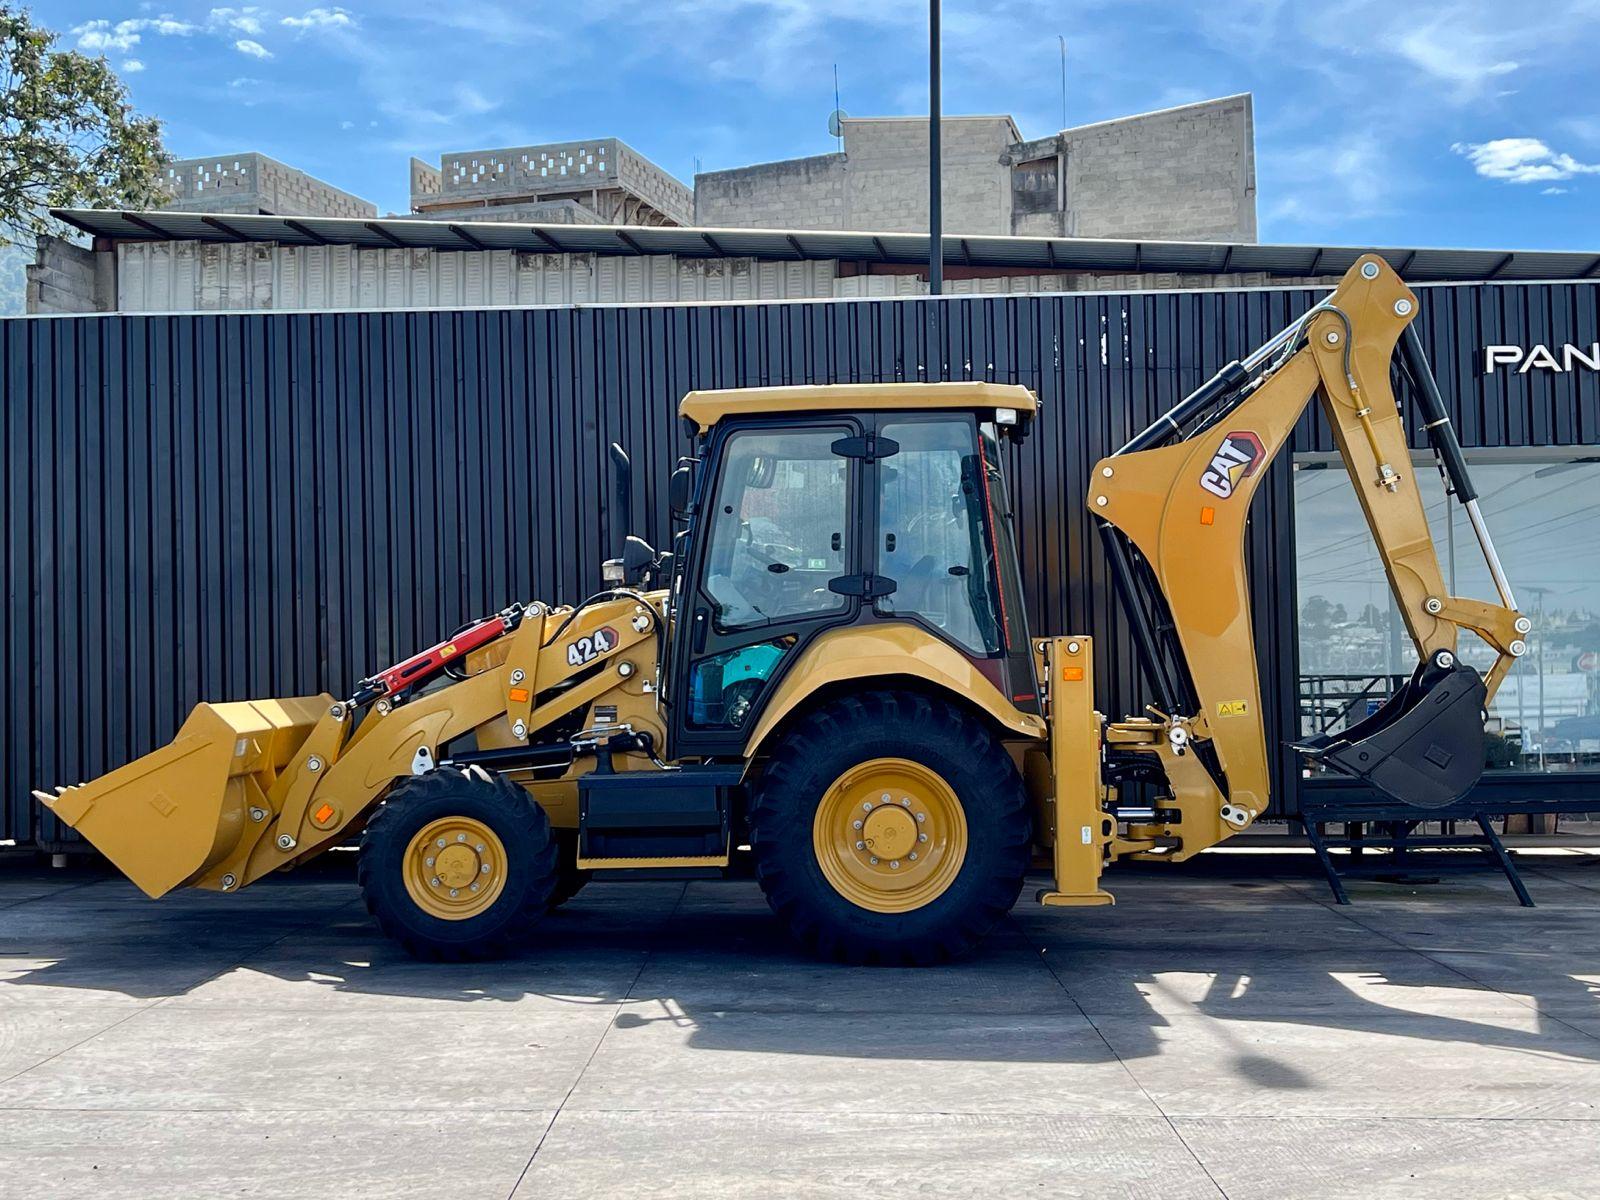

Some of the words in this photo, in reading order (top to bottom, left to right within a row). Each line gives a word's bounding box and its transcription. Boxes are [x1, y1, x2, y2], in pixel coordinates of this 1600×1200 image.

[1486, 342, 1600, 373] PAN
[1200, 438, 1252, 499] CAT
[567, 630, 609, 666] 424
